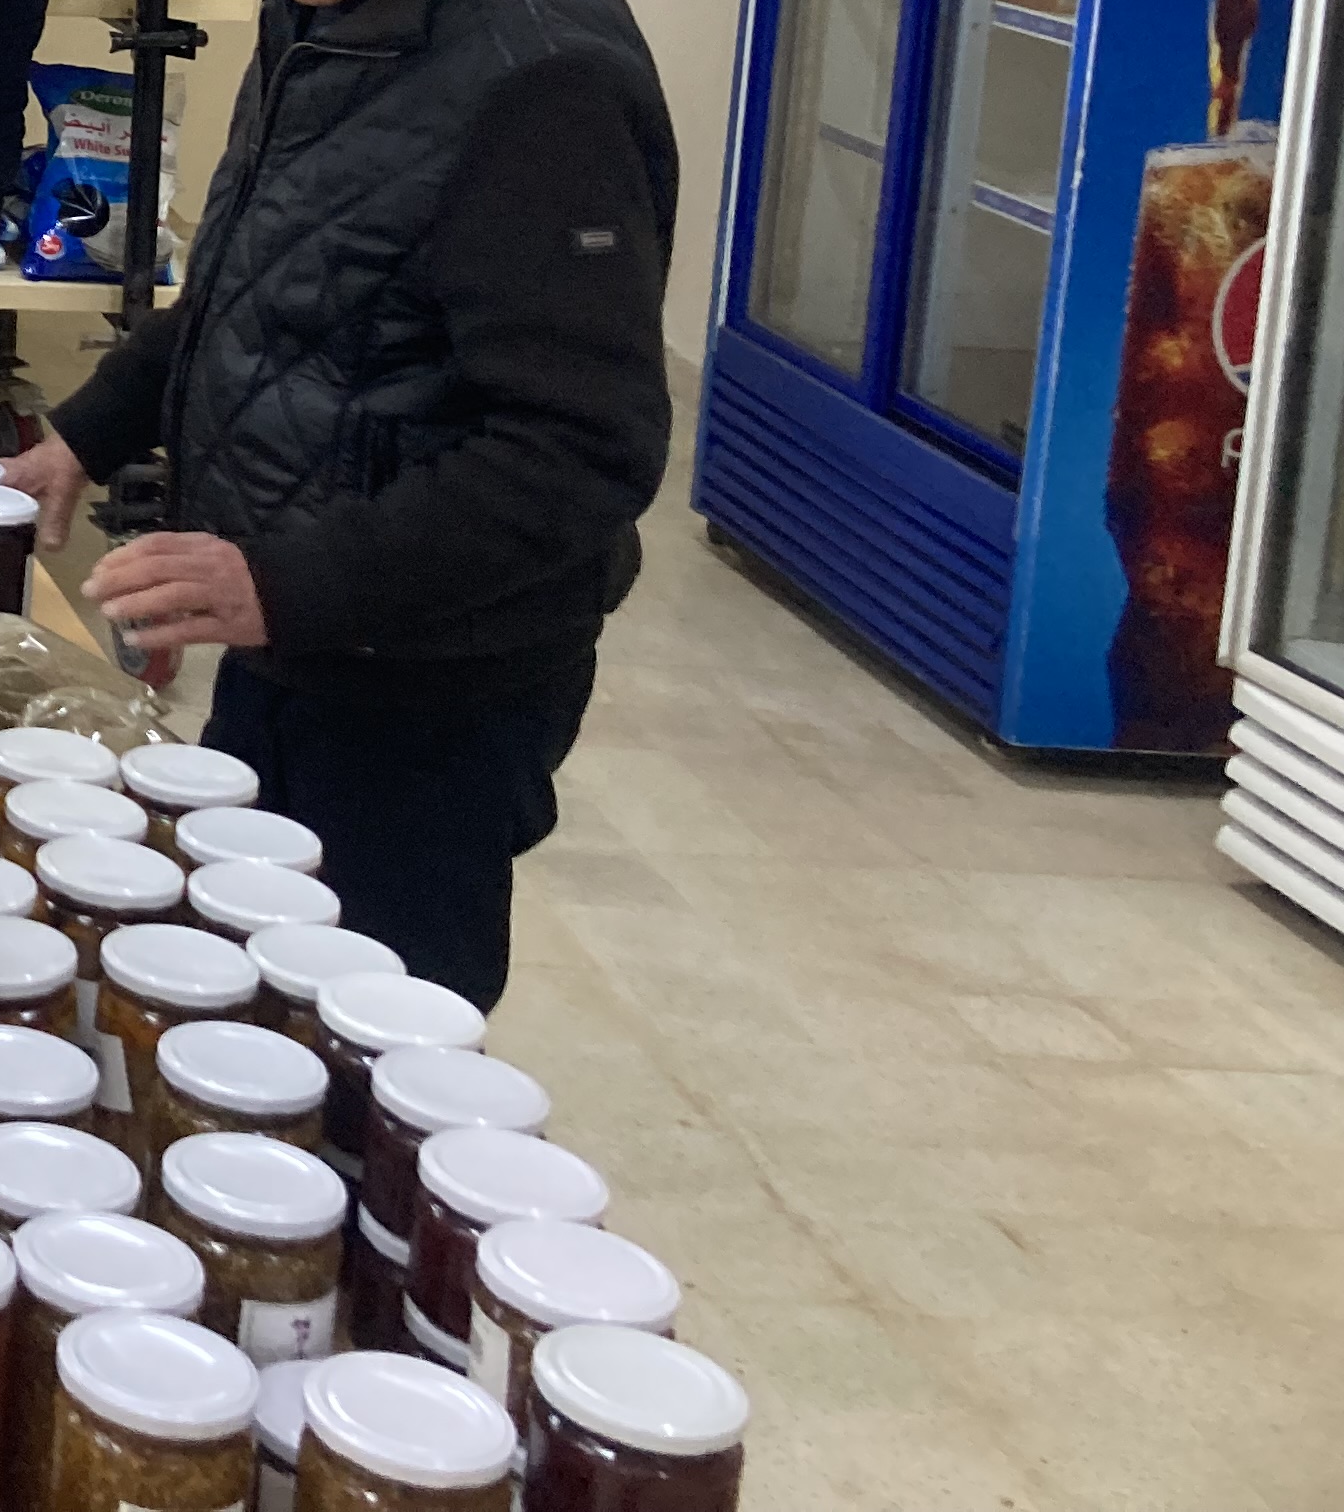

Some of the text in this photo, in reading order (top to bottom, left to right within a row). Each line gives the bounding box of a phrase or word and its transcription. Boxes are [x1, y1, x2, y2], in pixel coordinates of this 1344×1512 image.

[80, 91, 132, 107] Deron
[74, 139, 131, 156] White Su
